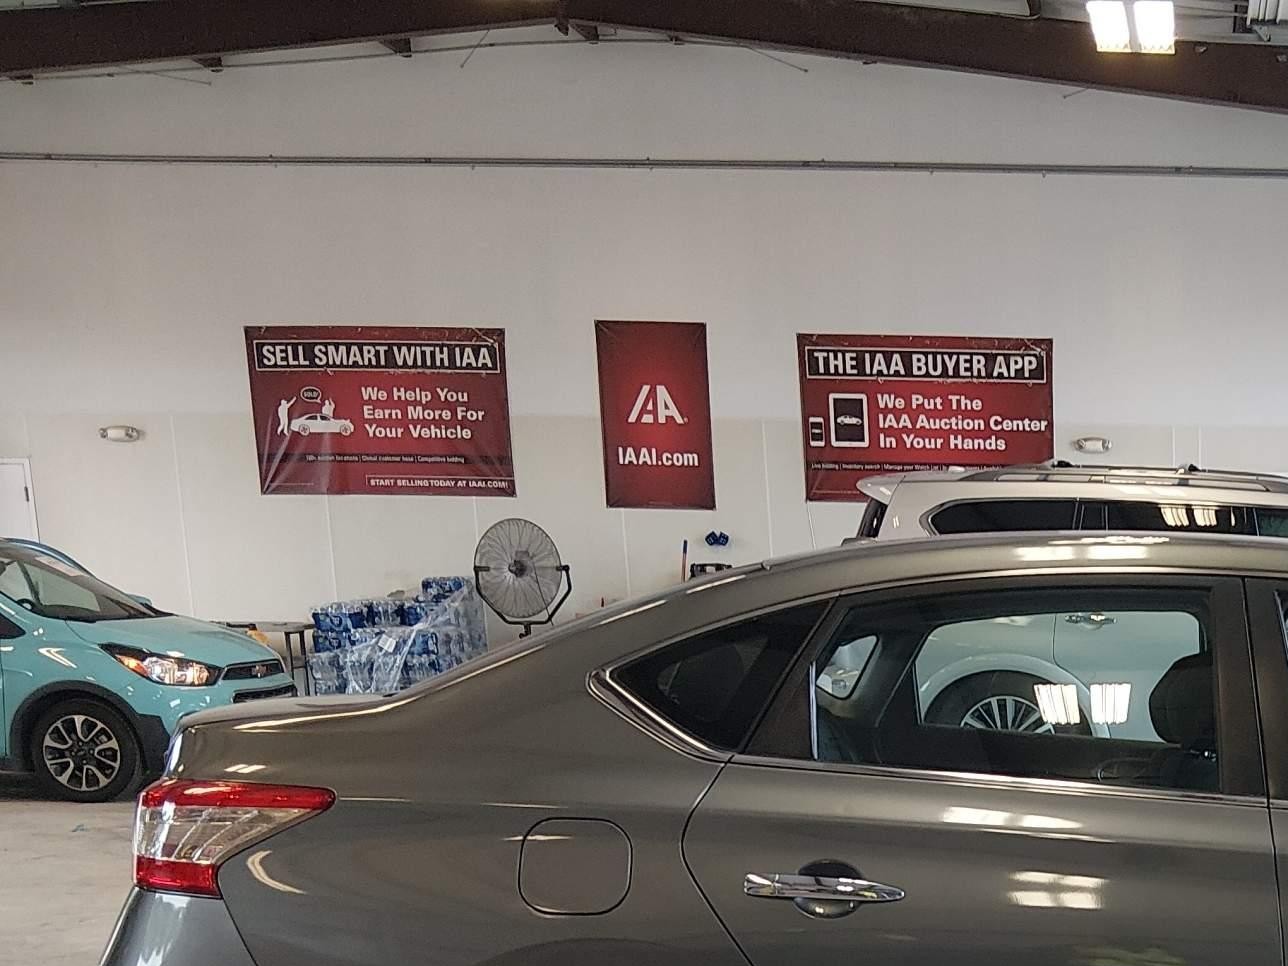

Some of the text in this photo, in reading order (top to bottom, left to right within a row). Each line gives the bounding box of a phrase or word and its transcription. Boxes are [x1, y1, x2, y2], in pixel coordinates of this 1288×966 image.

[262, 345, 492, 368] SELL SMART WITH IAA
[813, 351, 1038, 378] THE IAA BUYER APP
[361, 387, 468, 404] We Help You
[877, 393, 983, 411] We Put The
[363, 406, 484, 421] Earn More For
[364, 423, 472, 439] Your Vehicle
[878, 414, 1049, 432] IAA Auction Center
[879, 433, 1006, 451] In Your Hands
[618, 446, 699, 466] IAAI.com
[370, 478, 395, 486] START
[397, 479, 429, 487] SELLING
[429, 479, 456, 487] TODAY
